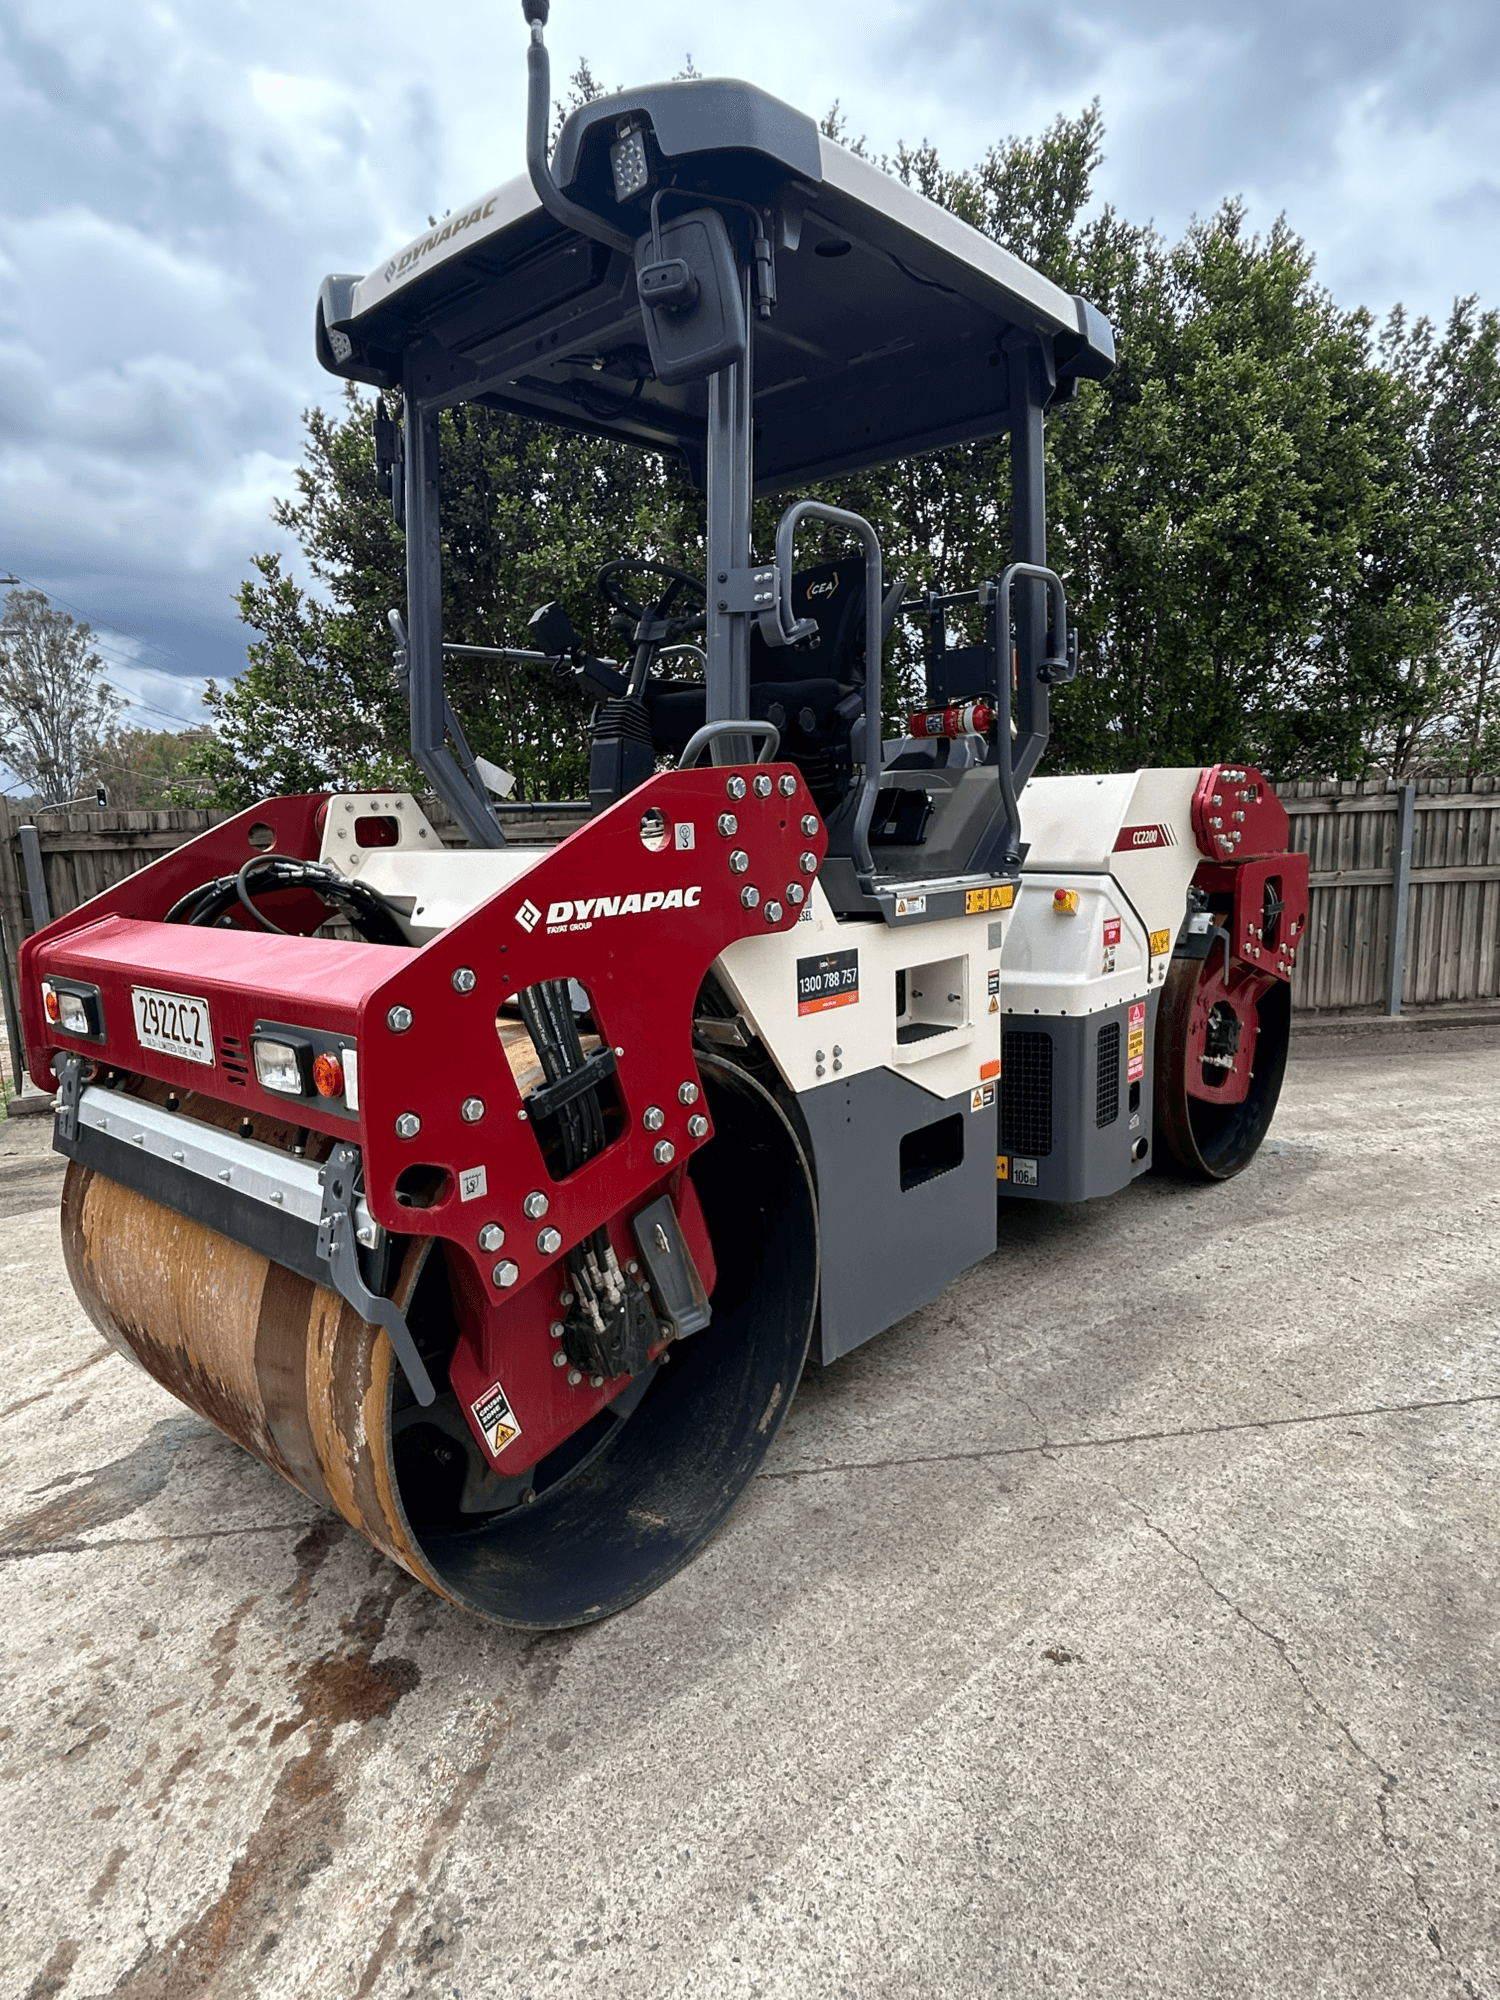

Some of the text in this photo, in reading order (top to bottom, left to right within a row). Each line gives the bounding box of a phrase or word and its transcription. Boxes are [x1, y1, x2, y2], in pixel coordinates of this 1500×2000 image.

[398, 197, 498, 272] DYNAPAC
[812, 582, 832, 595] CEA
[1133, 830, 1157, 845] CC2200
[546, 886, 701, 924] DYNAPAC
[547, 922, 592, 935] FAYAT GROUP
[800, 975, 821, 993] 1300
[823, 971, 840, 988] 788
[841, 968, 857, 984] 757
[139, 996, 204, 1048] 2922C2
[1014, 1170, 1029, 1183] 106
[479, 1395, 502, 1417] CRUSH
[482, 1405, 500, 1423] ZONE
